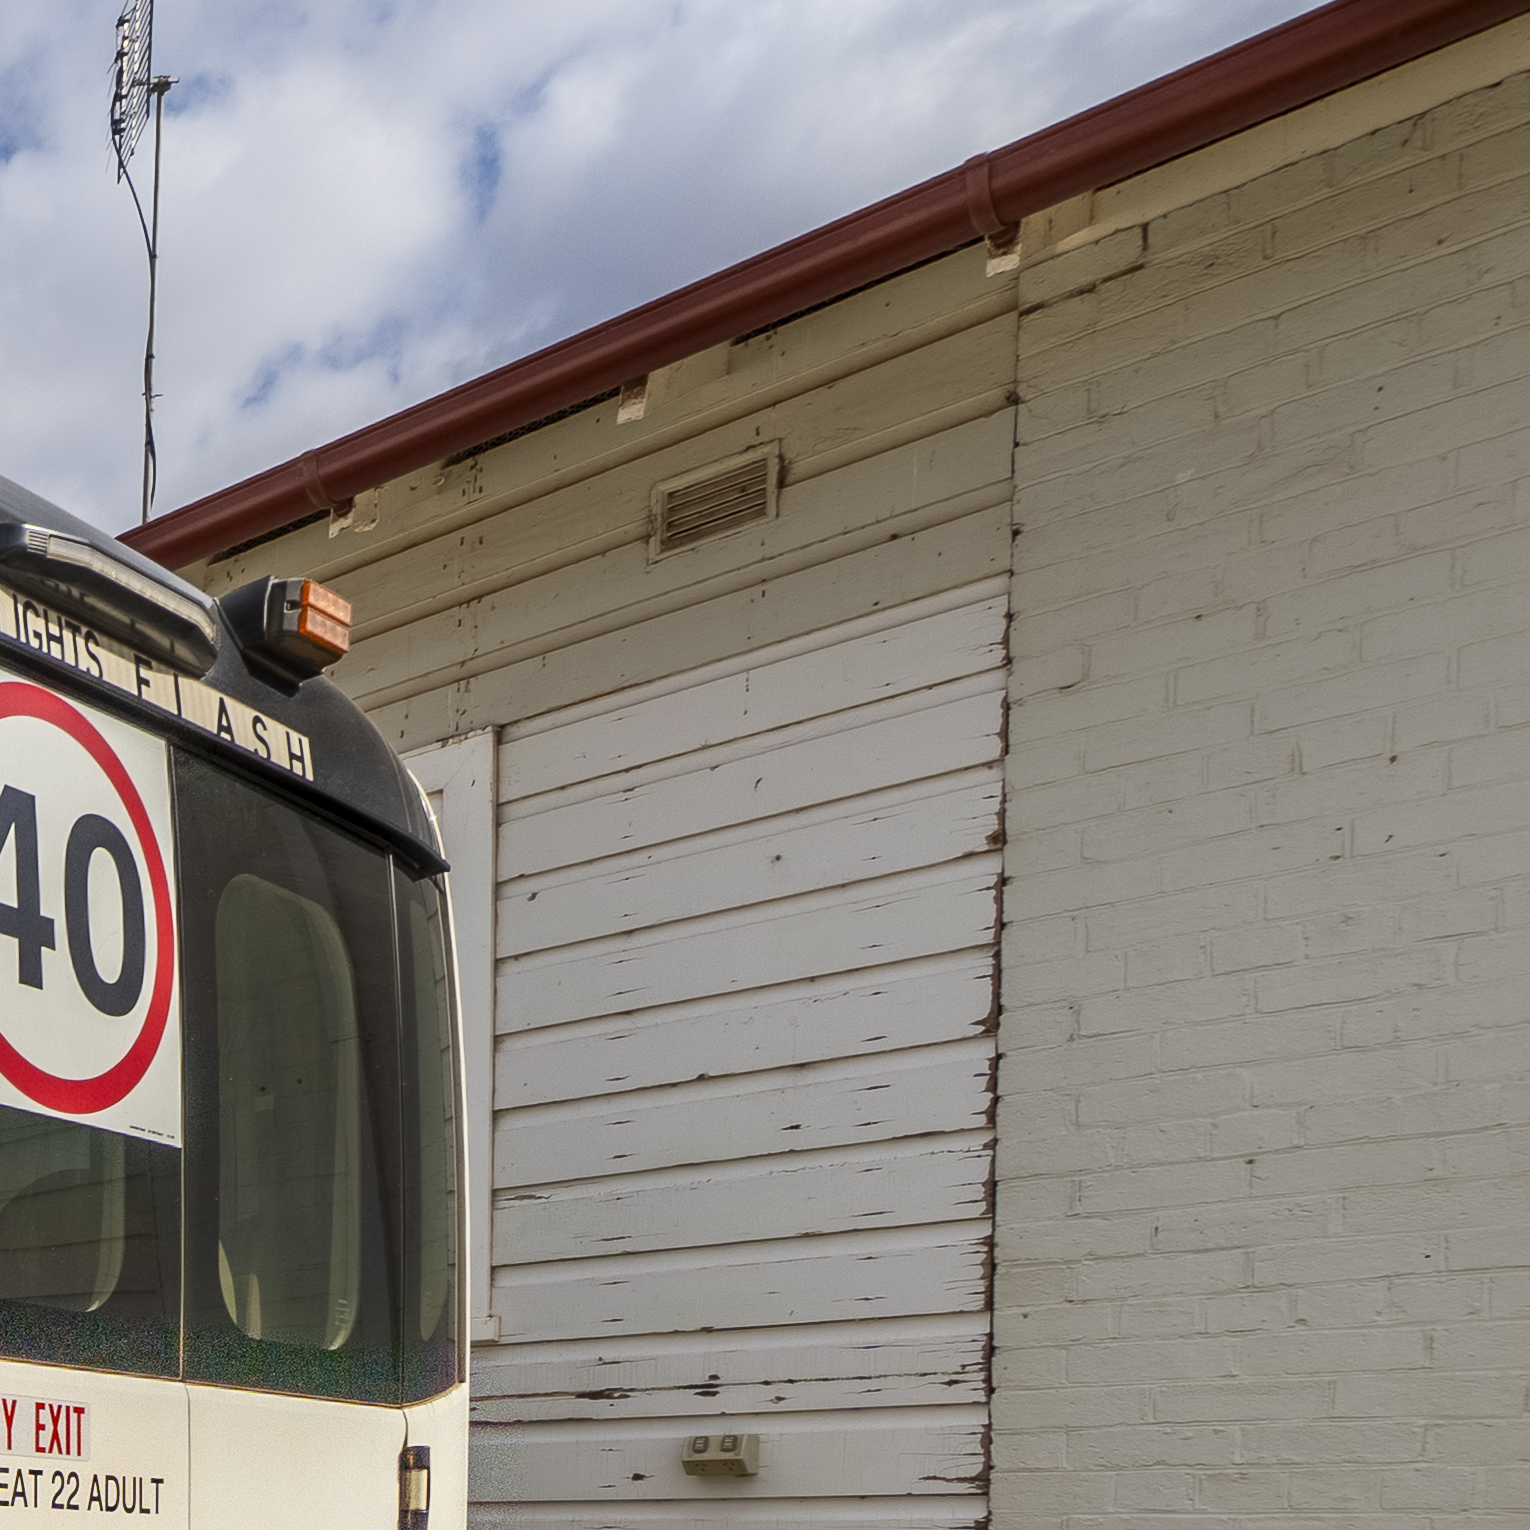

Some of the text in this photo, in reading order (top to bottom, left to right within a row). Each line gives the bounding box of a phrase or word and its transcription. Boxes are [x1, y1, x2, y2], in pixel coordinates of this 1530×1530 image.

[34, 1401, 85, 1457] EXIT
[51, 1472, 80, 1511] 22
[87, 1474, 165, 1515] ADULT
